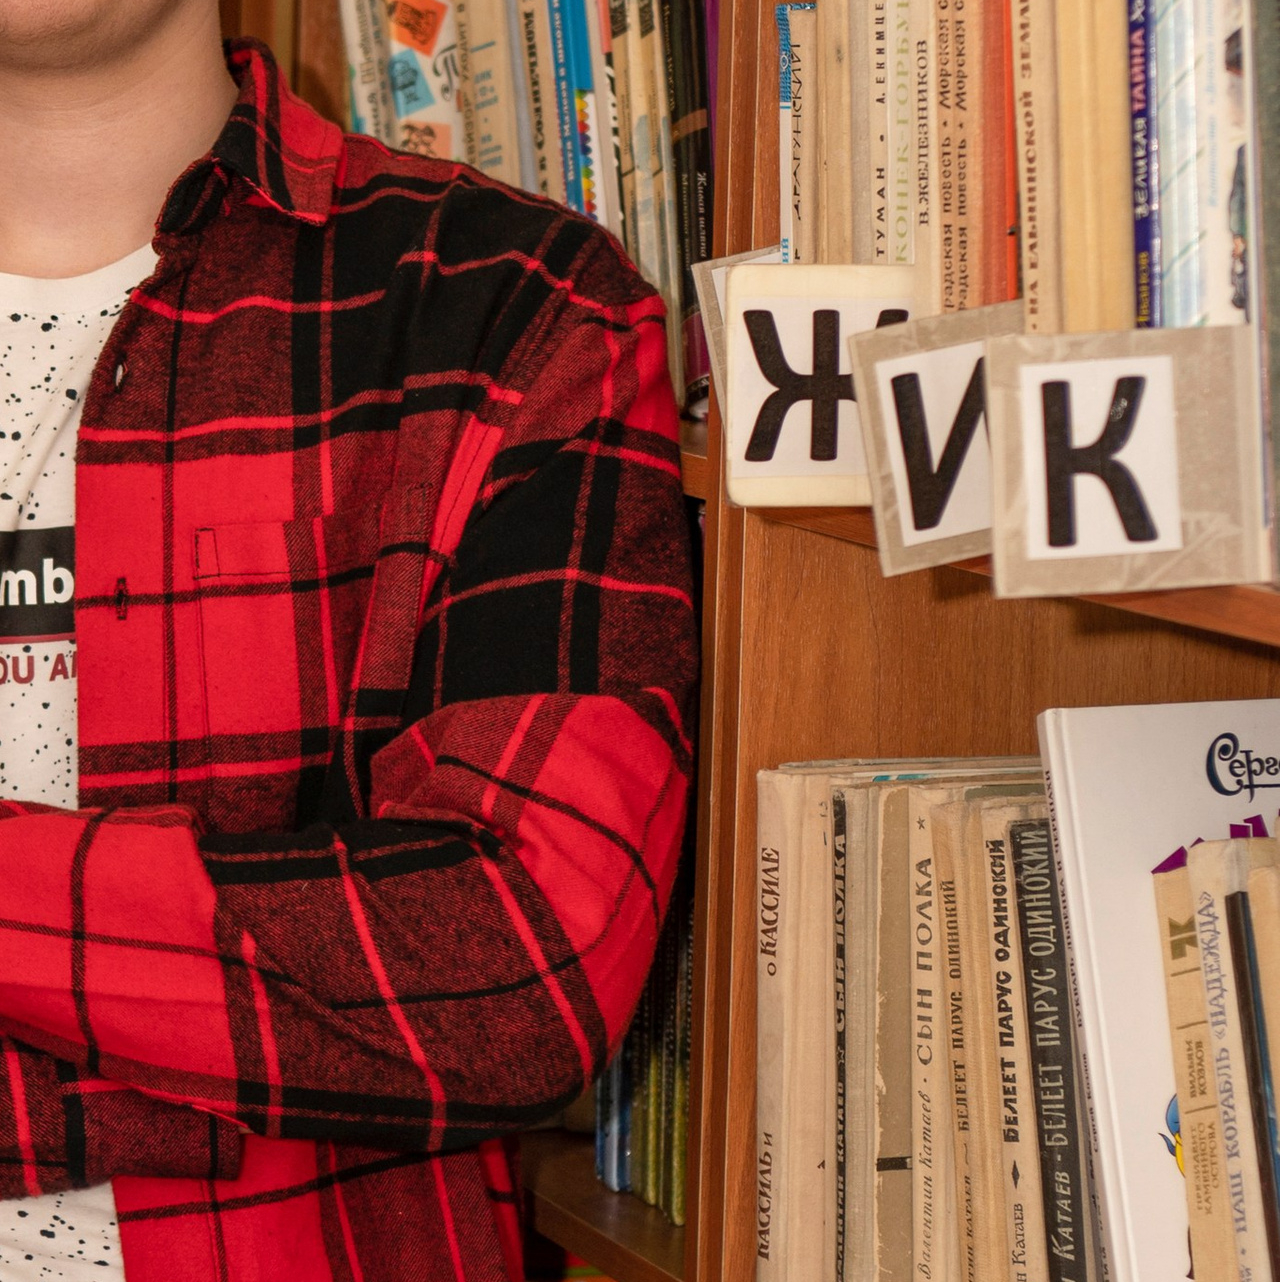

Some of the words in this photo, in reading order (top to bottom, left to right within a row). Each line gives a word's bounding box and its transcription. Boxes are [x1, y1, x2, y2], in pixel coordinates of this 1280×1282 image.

[875, 92, 885, 103] А.
[937, 17, 952, 109] Морская
[954, 19, 967, 111] Морская
[695, 171, 708, 214] Живая
[875, 166, 885, 256] ТУМАН
[940, 136, 952, 214] повесть
[956, 137, 967, 216] повесть
[1018, 90, 1040, 269] ЕЛЬНИНСКОЙ
[698, 216, 708, 257] шляпа
[940, 222, 954, 309] радская
[956, 225, 969, 311] радская
[1027, 279, 1039, 315] НА
[1040, 376, 1160, 549] К
[49, 653, 77, 682] A
[1206, 732, 1280, 803] Серг
[760, 847, 778, 958] КАССИЛЕ
[914, 857, 932, 970] ПОЛКА
[939, 879, 961, 979] ОДИНОКИЙ
[984, 838, 1011, 962] ОДИНОКИЙ
[1017, 827, 1056, 957] ОДИНОКИЙ
[765, 961, 777, 977] о
[1030, 966, 1061, 1047] ПАРУС
[1195, 889, 1233, 1040] «НАДЕЖДА»
[916, 988, 933, 1065] СЫН
[948, 989, 965, 1049] ПАРУС
[994, 970, 1016, 1047] ПАРУС
[952, 1058, 970, 1132] БЕЛЕЕТ
[998, 1056, 1020, 1142] БЕЛЕЕТ
[1038, 1062, 1069, 1147] БЕЛЕЕТ
[1184, 1038, 1199, 1098] ВИЛЬЯМ
[1194, 1039, 1208, 1096] КОЗЛОВ
[1214, 1046, 1243, 1159] КОРАБЛЬ
[762, 1130, 773, 1146] и
[917, 1092, 932, 1169] Катаев
[1189, 1123, 1205, 1210] ПРЕЗИДЕНТ
[1195, 1120, 1214, 1215] КАМЕННОГО
[1205, 1121, 1221, 1189] ОСТРОВА
[756, 1150, 772, 1261] КАССИЛЬ
[918, 1176, 933, 1279] Валентин
[1047, 1169, 1077, 1262] КАТАЕВ
[1228, 1173, 1249, 1234] НАШ
